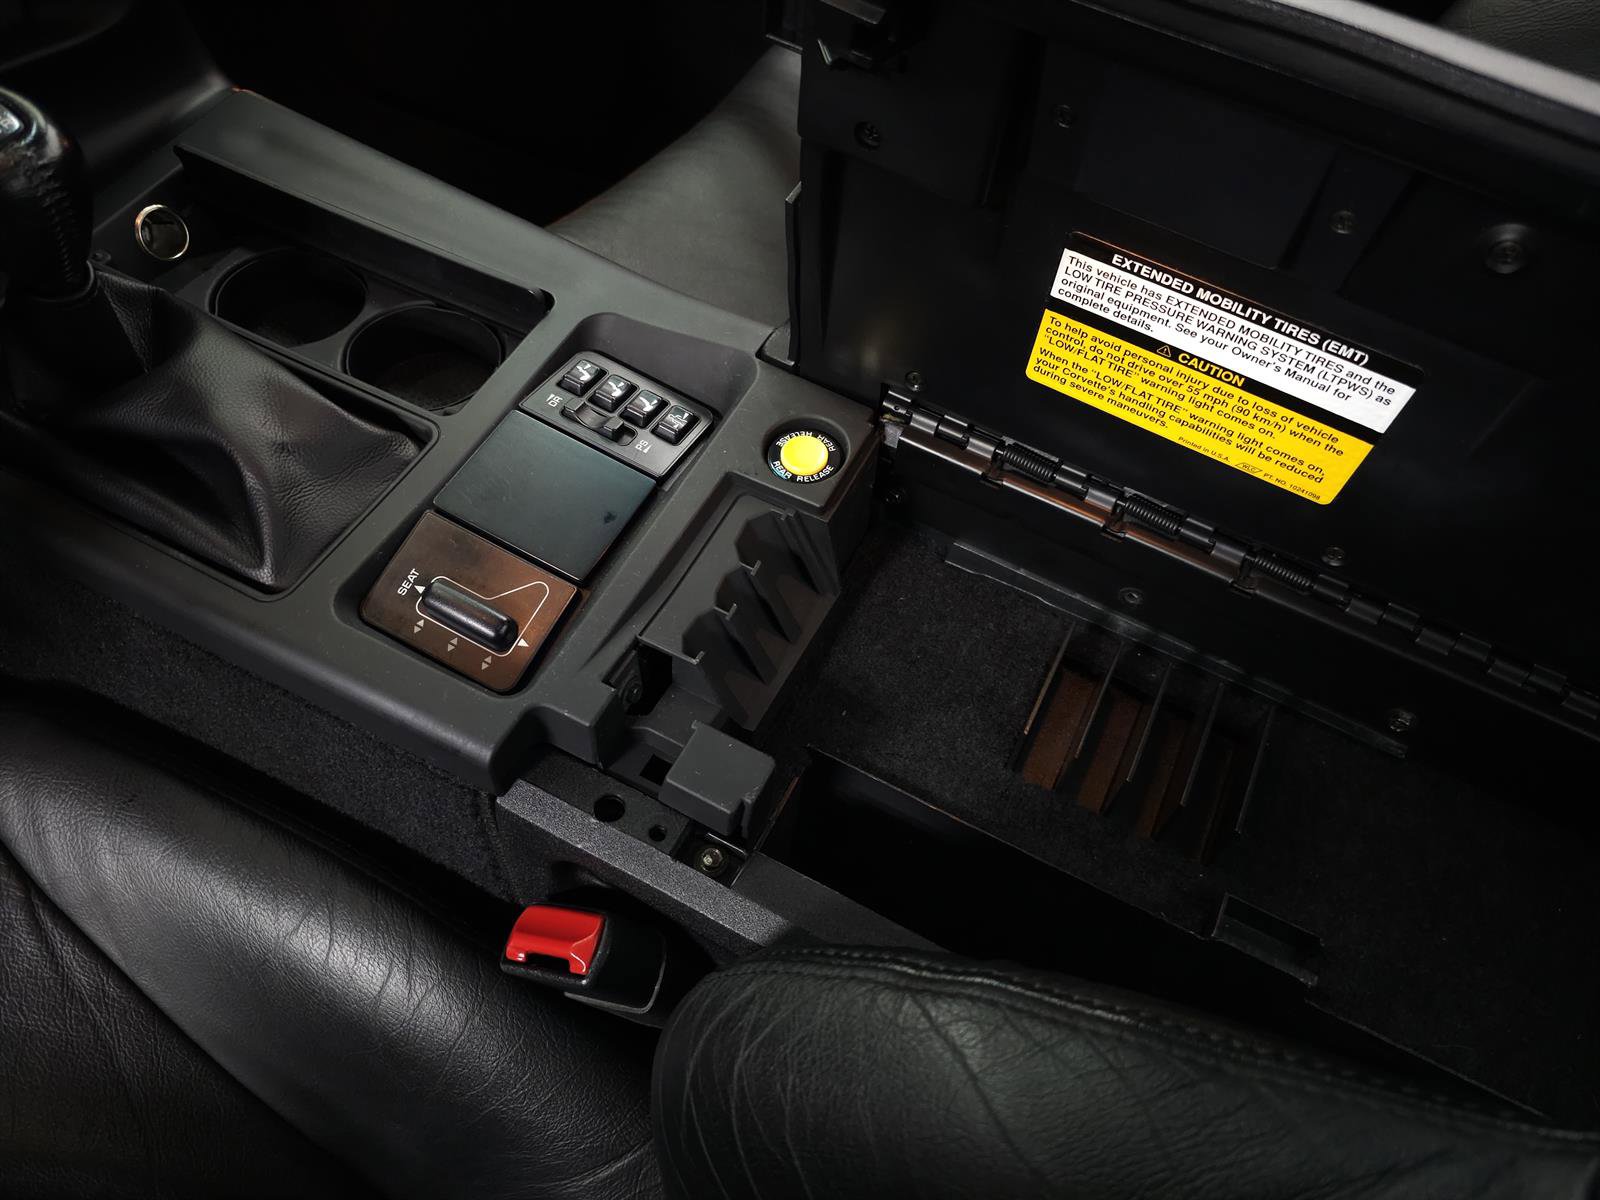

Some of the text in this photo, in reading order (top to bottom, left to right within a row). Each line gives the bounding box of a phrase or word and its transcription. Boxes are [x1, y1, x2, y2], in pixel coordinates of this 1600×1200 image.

[1058, 287, 1154, 333] complete details.
[1061, 277, 1354, 402] original equipment. See your Owner's Manual for
[1064, 265, 1393, 408] LOW TIRE PRESSURE WARNING SYSTEM (LTPWS) as
[1068, 255, 1396, 396] This vehicle has EXTENDED MOBILITY TIRES and the
[1111, 253, 1370, 367] EXTENDED MOBILITY TIRES (EMT)
[547, 395, 563, 408] DR
[1032, 365, 1168, 429] during severe maneuvers.
[1045, 326, 1346, 458] control, do not drive over 55 mph (90 km/h) when the
[1048, 315, 1340, 445] To help avoid personal injury due to loss of vehicle
[1177, 352, 1246, 388] CAUTION
[1035, 357, 1325, 485] your Corvette's handling capabilities will be reduced
[1038, 347, 1070, 366] When
[1071, 360, 1090, 374] the
[1188, 412, 1235, 438] warning
[1235, 431, 1265, 449] light
[1264, 445, 1305, 468] comes
[1306, 463, 1326, 477] on,
[1140, 375, 1186, 402] warning
[1187, 396, 1216, 414] light
[1215, 408, 1256, 431] comes
[1257, 426, 1276, 440] on.
[773, 460, 834, 483] REAR RELEASE
[775, 430, 837, 453] REAR RELEASE
[1178, 436, 1203, 451] Printed
[1263, 472, 1321, 501] PT. NO. 10241098
[396, 568, 420, 596] SEAT
